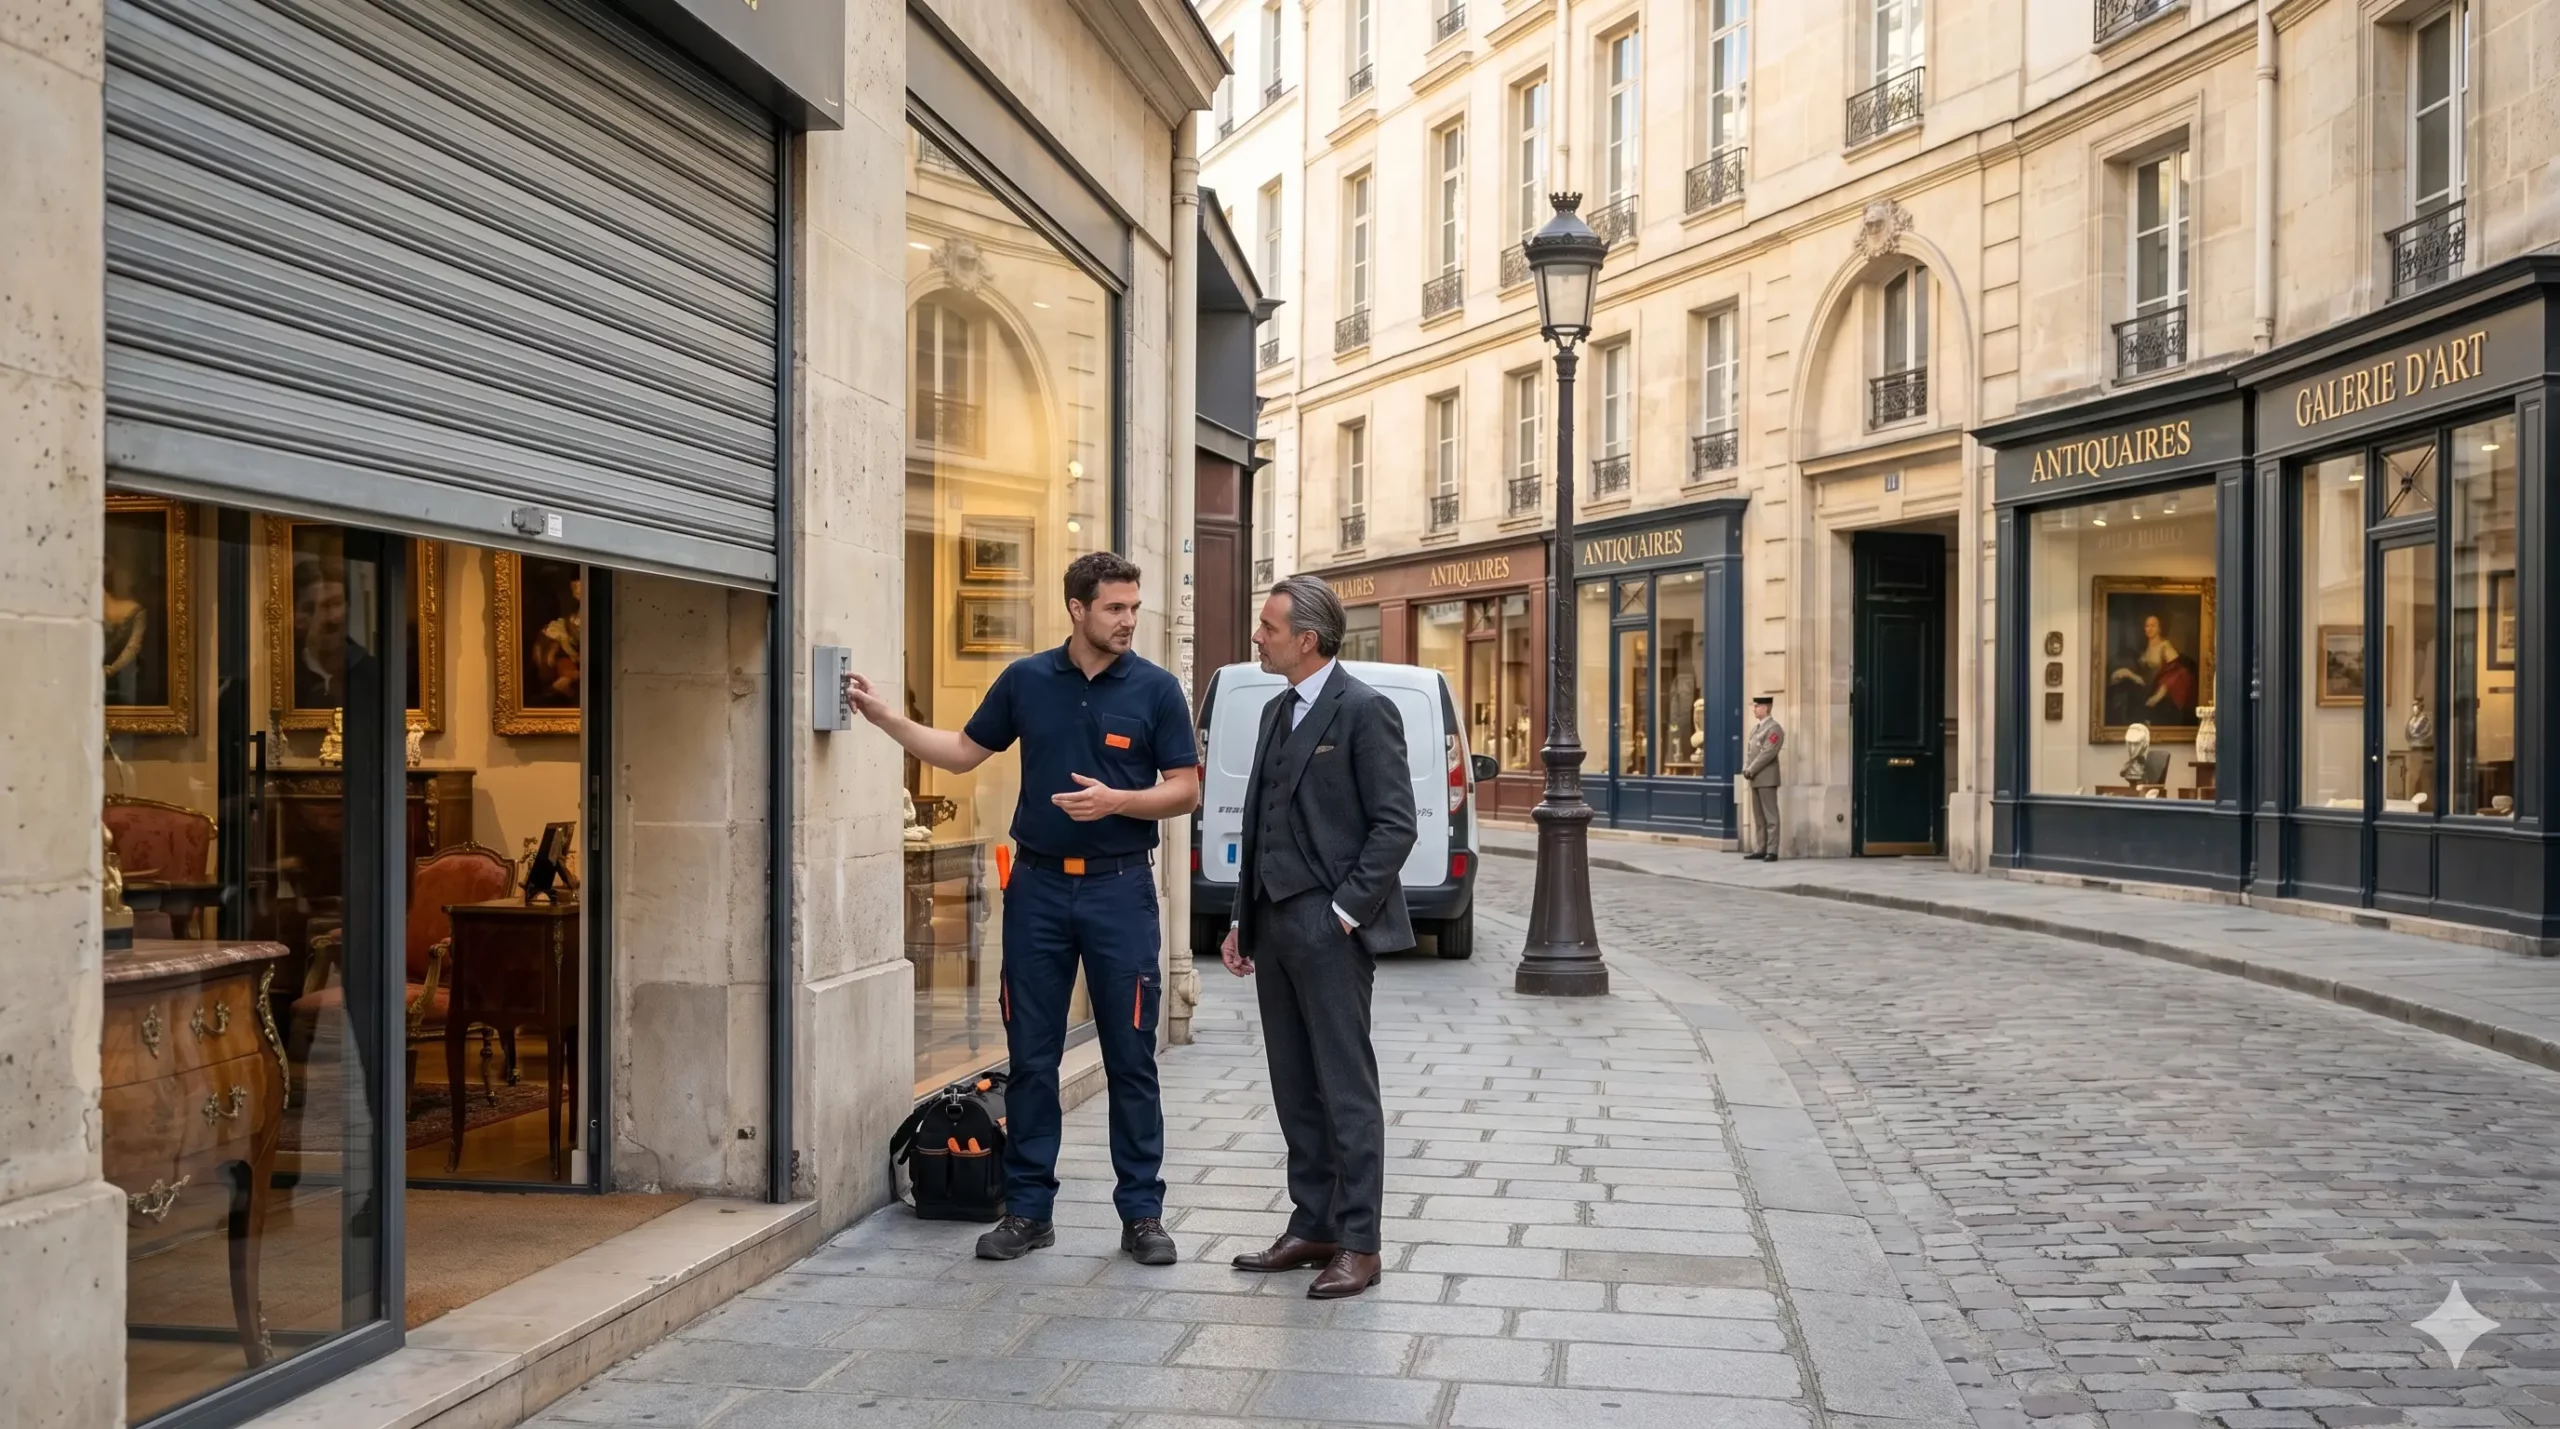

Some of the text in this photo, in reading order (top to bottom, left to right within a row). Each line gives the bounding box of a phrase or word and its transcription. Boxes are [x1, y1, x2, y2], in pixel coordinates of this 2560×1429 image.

[2296, 331, 2487, 427] GALERIE D'ART
[2030, 420, 2192, 483] ANTIQUAIRES
[1583, 528, 1683, 565] ANTIQUAIRES
[1429, 556, 1510, 588] ANTIQUAIRES
